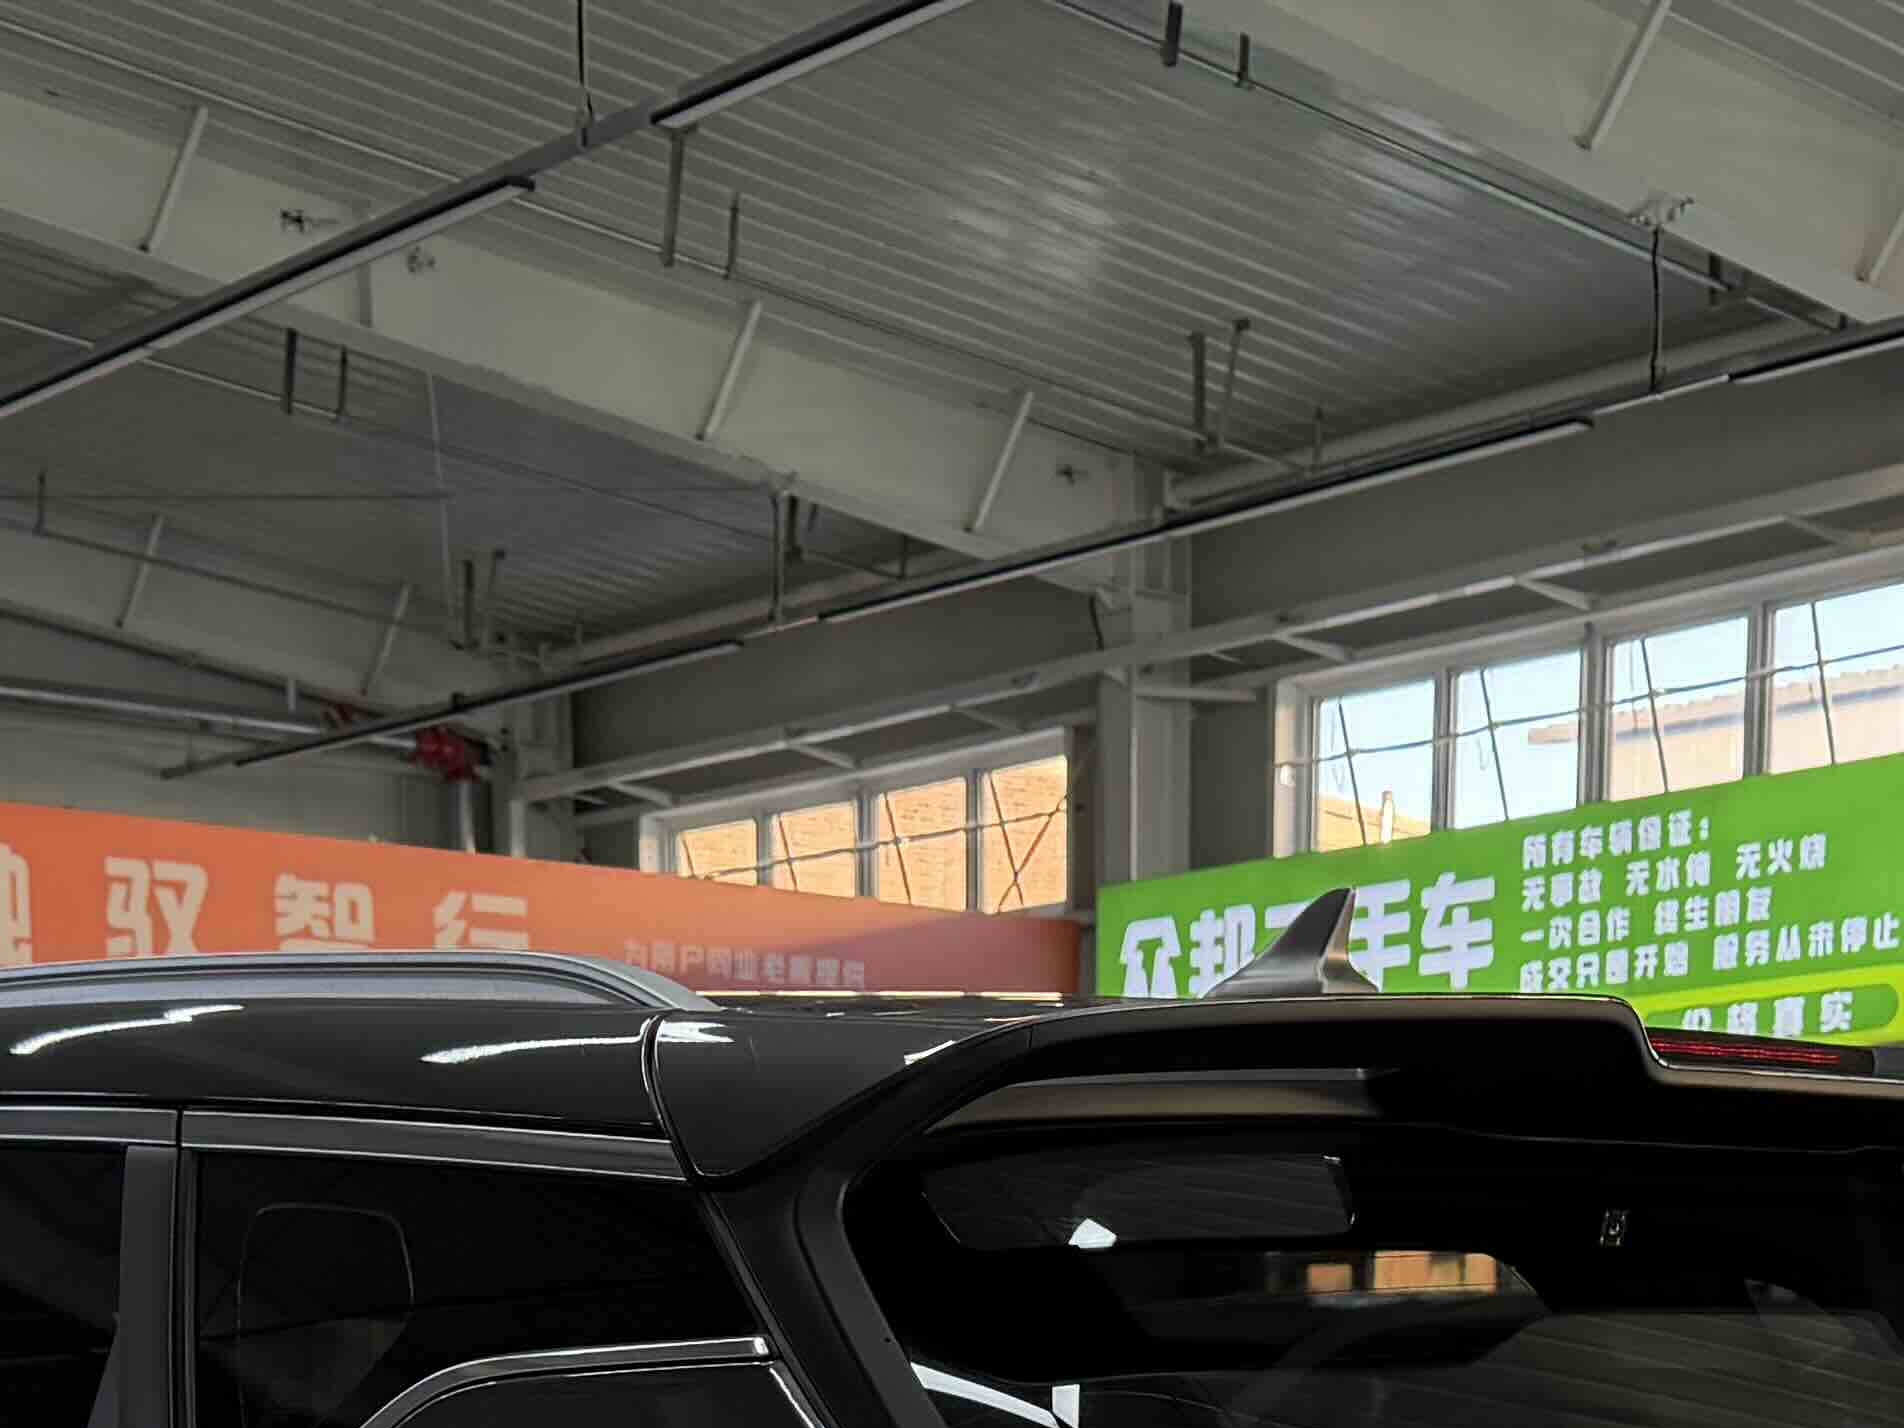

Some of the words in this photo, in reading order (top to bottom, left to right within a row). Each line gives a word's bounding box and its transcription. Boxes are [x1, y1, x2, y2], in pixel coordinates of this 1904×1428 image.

[1521, 868, 1602, 912] 无事故
[1736, 832, 1828, 881] 无火烧
[1120, 872, 1495, 999] 众邦手车
[1520, 906, 1631, 950] 一次合作
[1713, 911, 1901, 970] 服务从未停止
